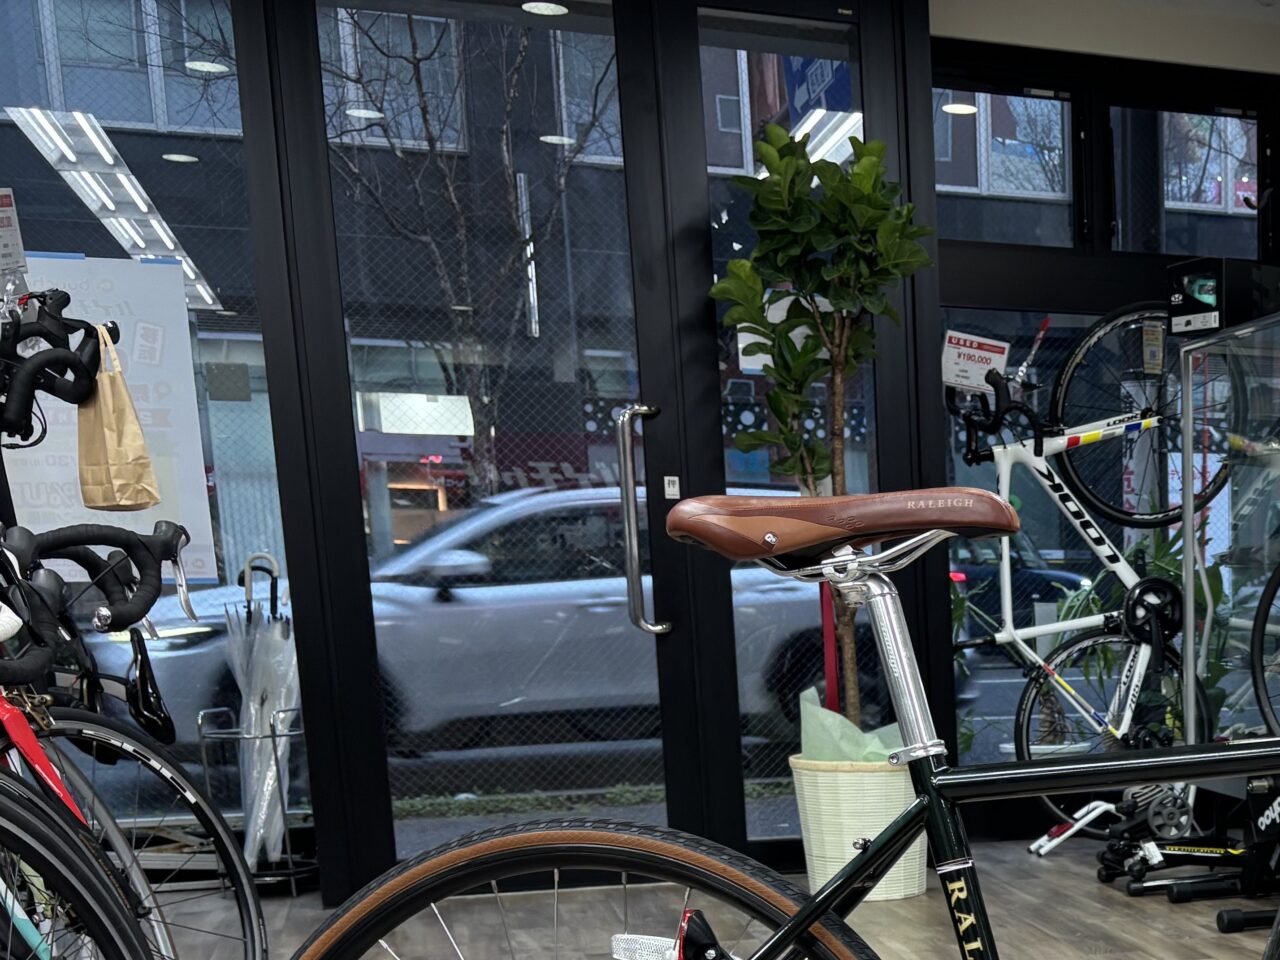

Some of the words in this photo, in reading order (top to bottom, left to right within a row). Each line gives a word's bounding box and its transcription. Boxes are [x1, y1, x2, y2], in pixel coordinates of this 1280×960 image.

[952, 337, 978, 348] USED
[1106, 413, 1140, 427] LOOK
[907, 498, 974, 509] RALEIGH
[1033, 465, 1121, 564] LOOK
[1123, 650, 1138, 687] LOOK
